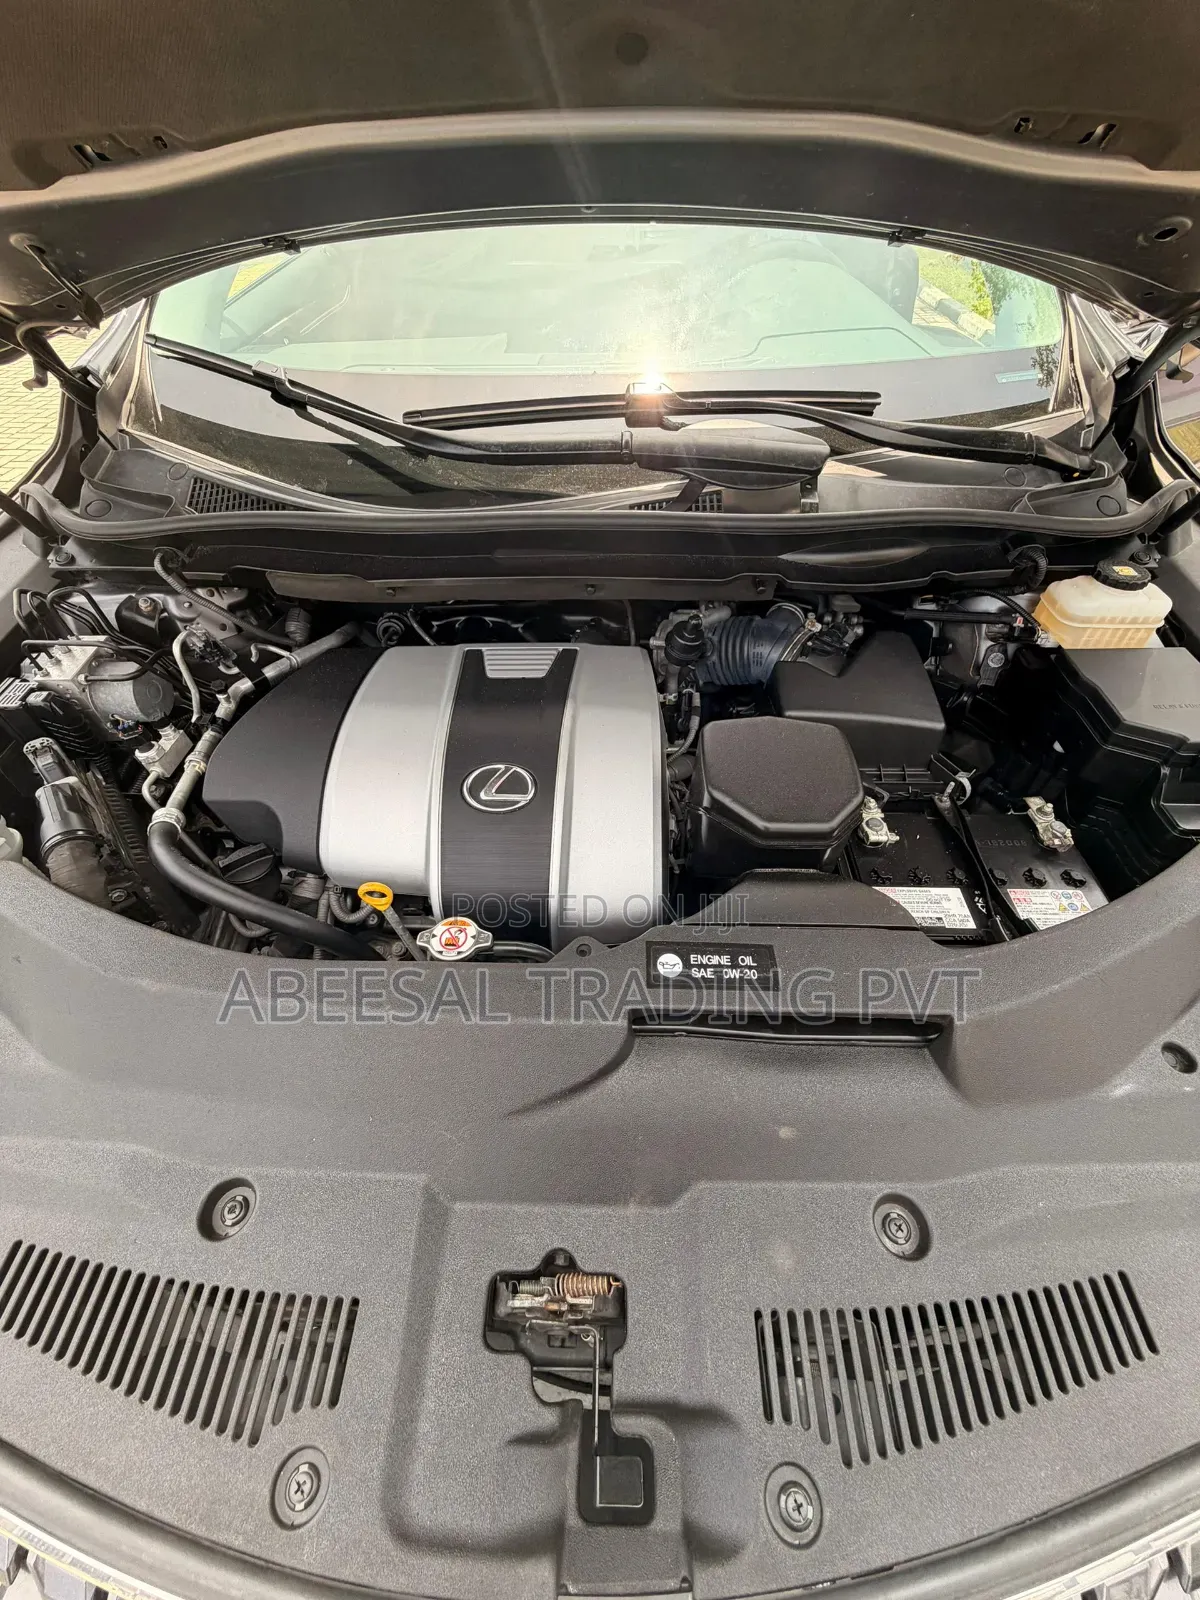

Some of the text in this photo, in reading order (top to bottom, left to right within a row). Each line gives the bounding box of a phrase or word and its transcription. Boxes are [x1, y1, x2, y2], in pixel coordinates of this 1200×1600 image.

[690, 954, 757, 966] ENGINE OIL
[691, 967, 758, 979] SAE 0W-20
